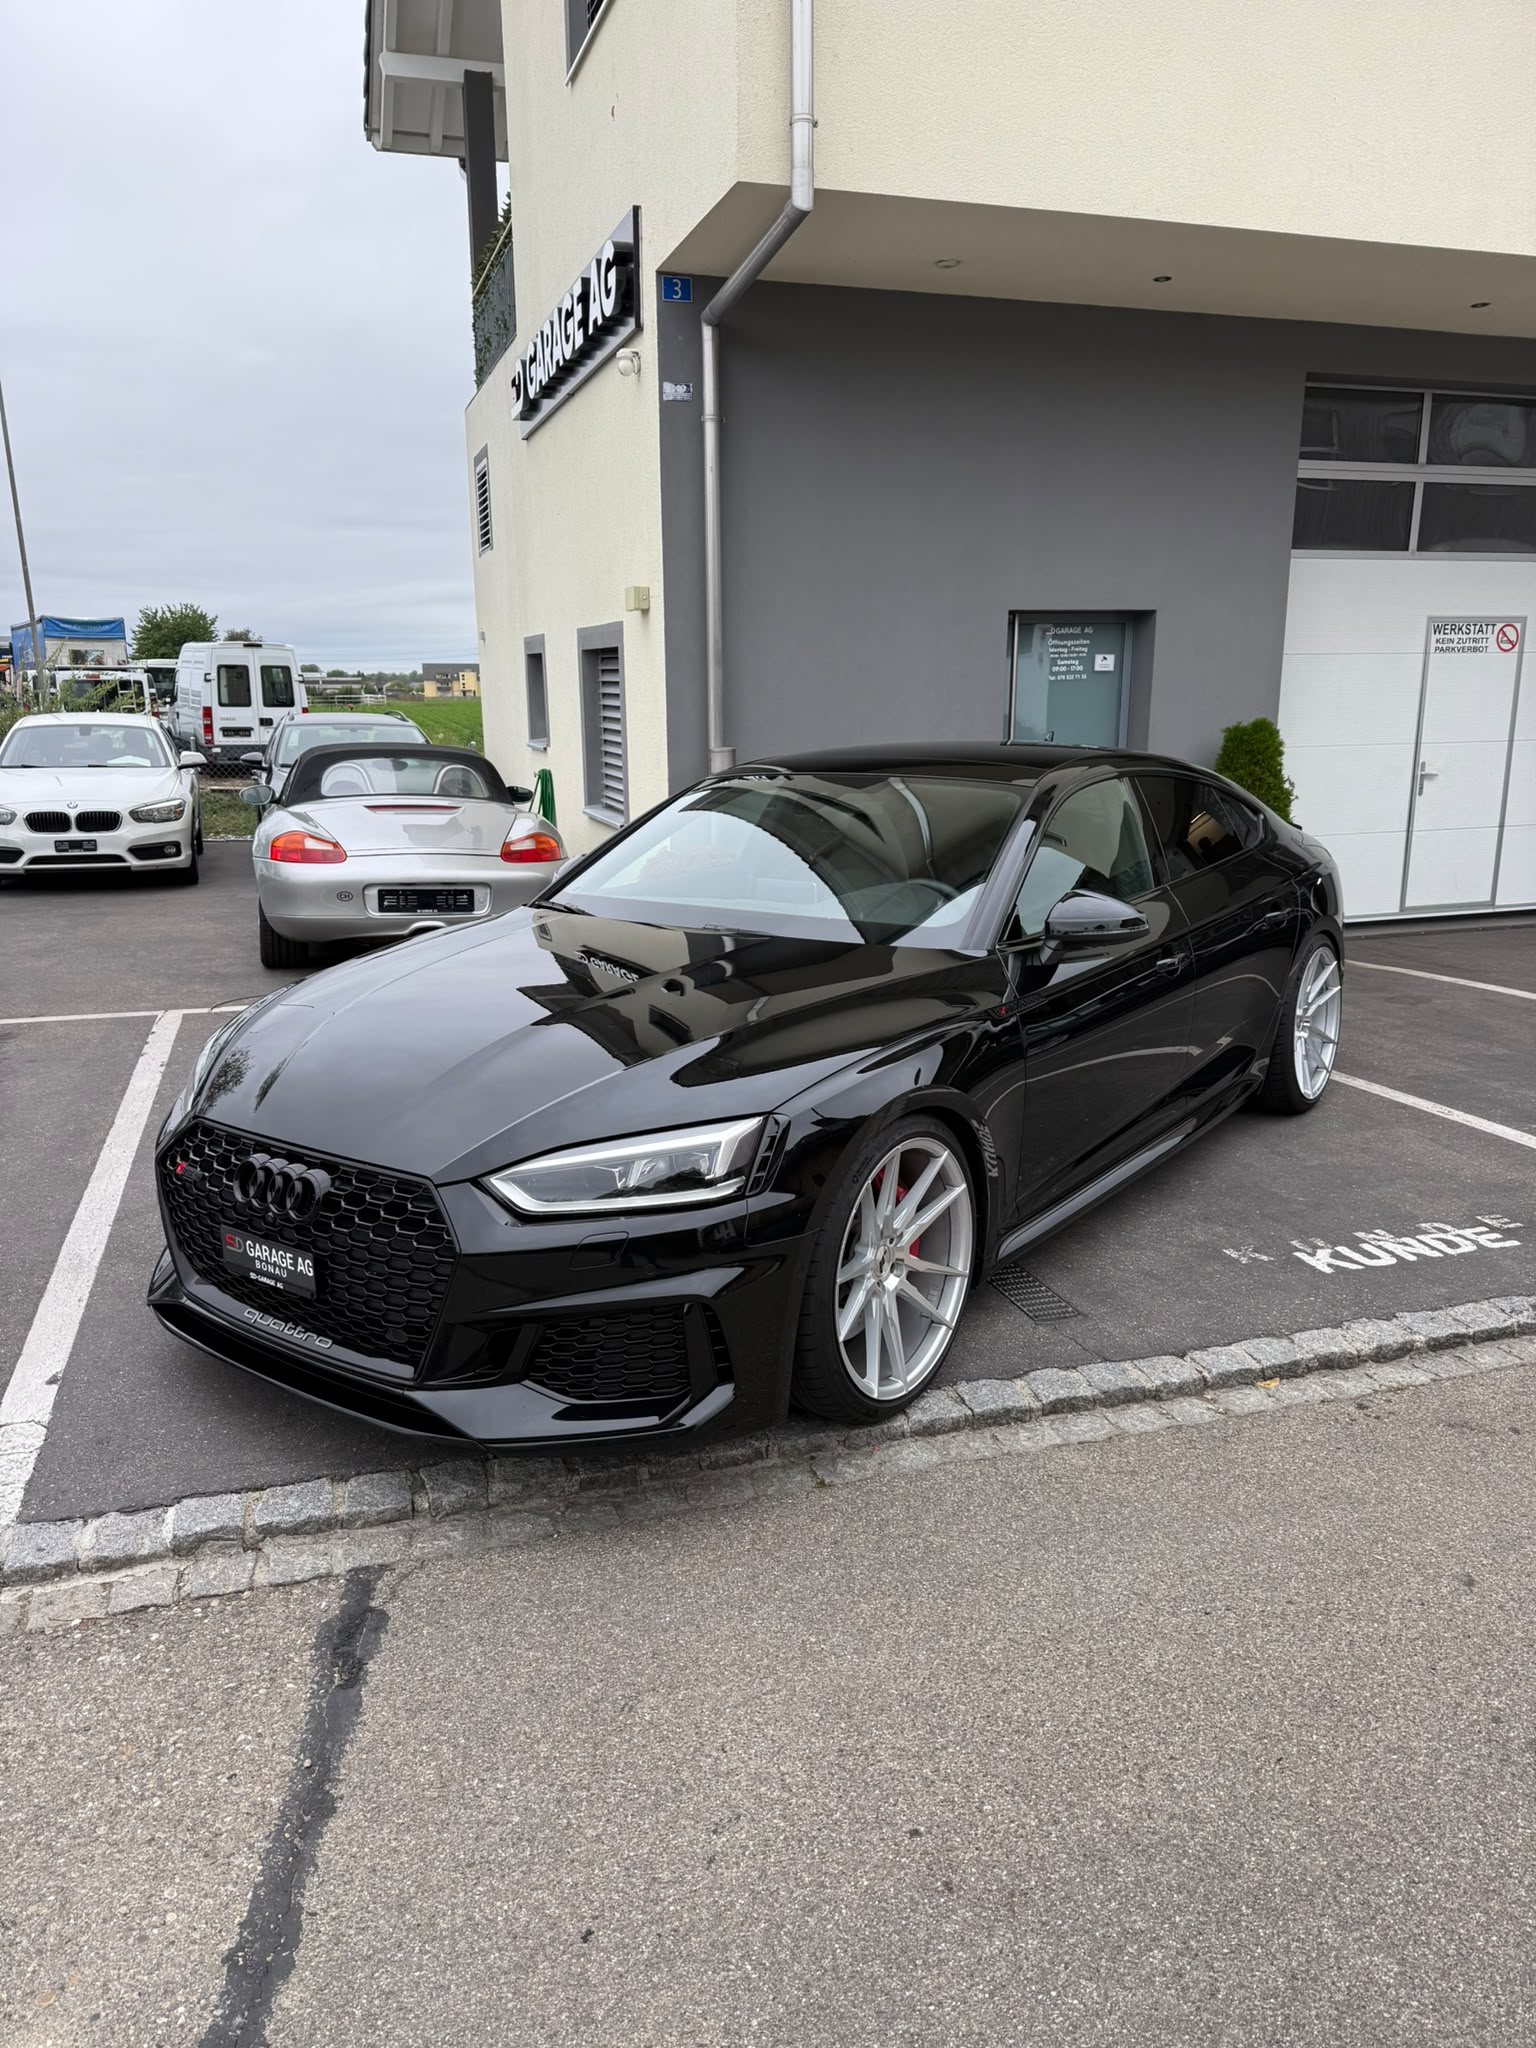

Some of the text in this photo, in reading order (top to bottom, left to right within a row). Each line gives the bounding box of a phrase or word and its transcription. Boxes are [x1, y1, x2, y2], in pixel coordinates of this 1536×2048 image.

[672, 279, 682, 299] 3
[526, 276, 584, 399] GARAGE
[589, 240, 617, 335] AG
[1056, 626, 1082, 634] GARAGE
[1084, 626, 1093, 634] AG
[1432, 623, 1497, 635] WERKSTATT
[224, 1233, 313, 1277] SD GARAGE AG
[1293, 1226, 1522, 1274] KUNDE
[255, 1259, 287, 1278] BONAU
[243, 1308, 333, 1349] quattro
